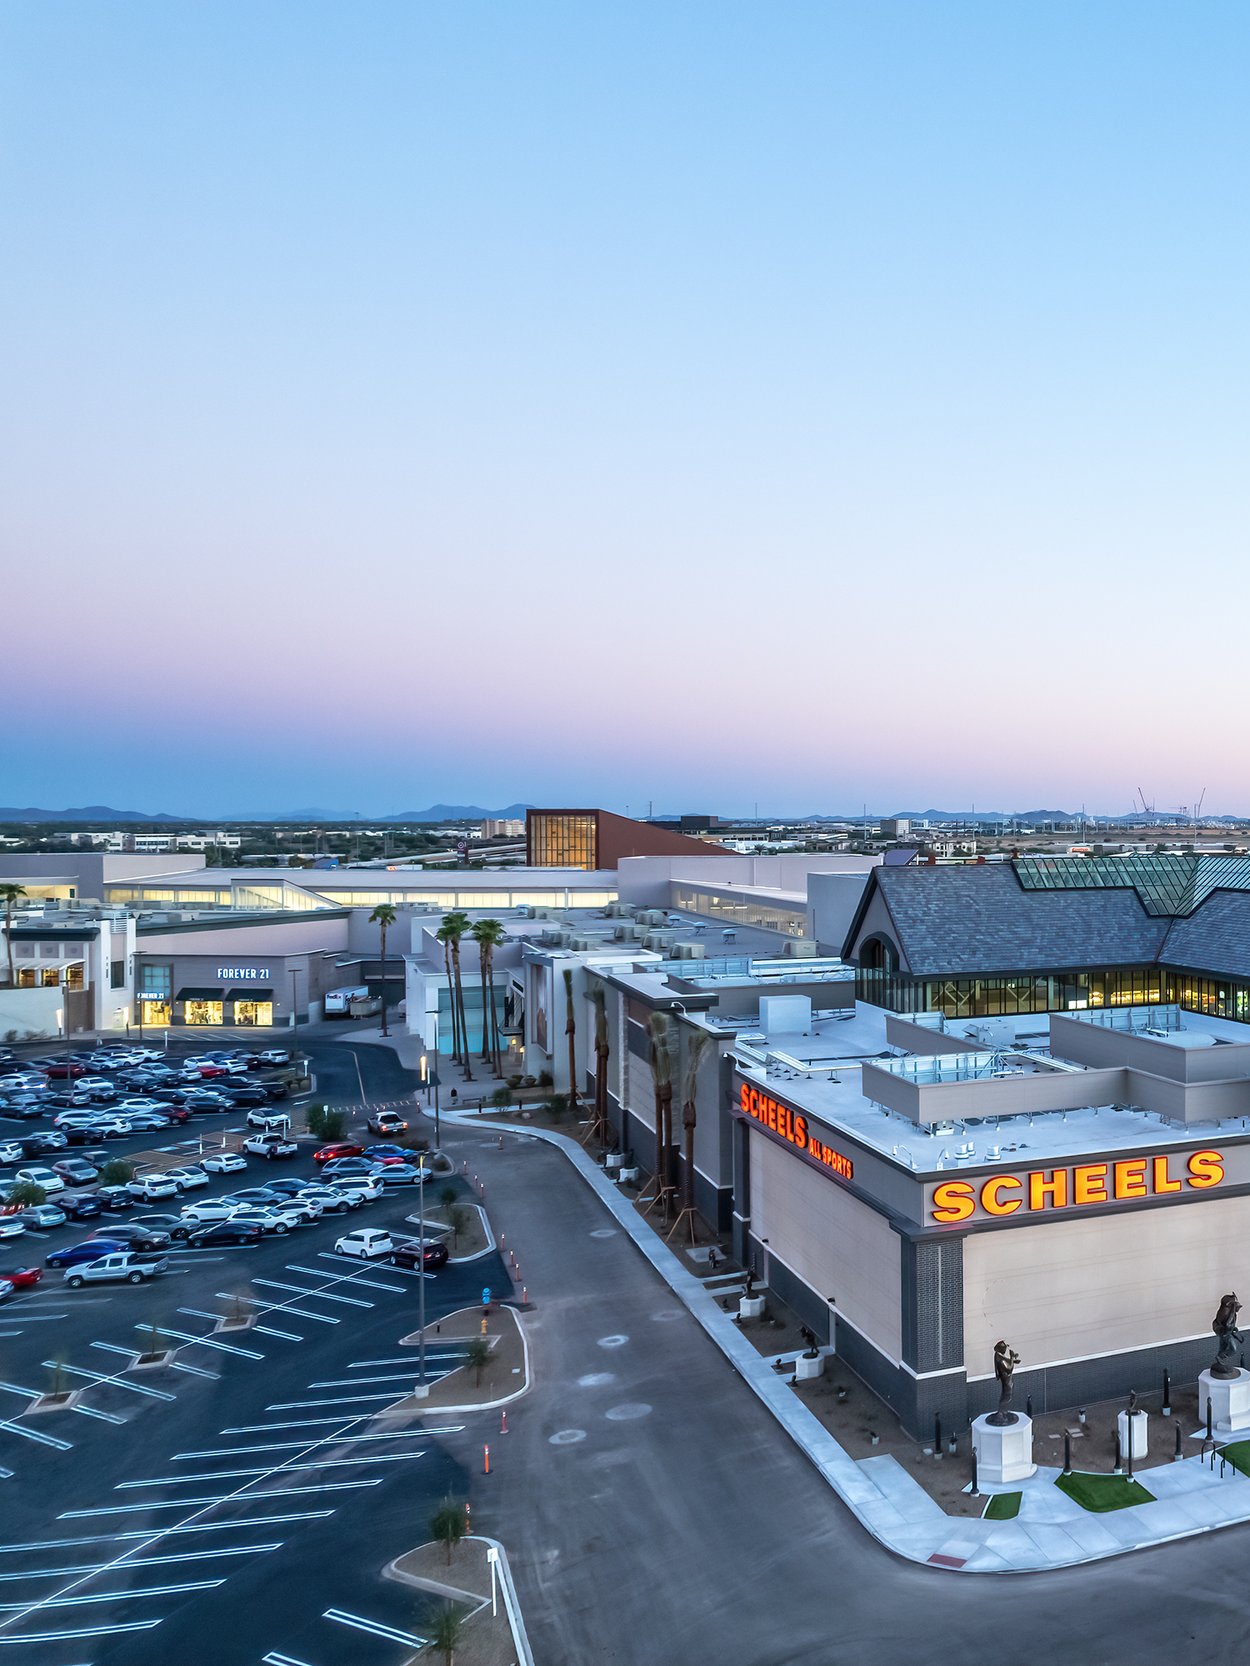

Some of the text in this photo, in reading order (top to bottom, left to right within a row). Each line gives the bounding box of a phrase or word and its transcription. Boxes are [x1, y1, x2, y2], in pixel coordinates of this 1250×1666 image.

[217, 968, 269, 979] FOREVER 21
[740, 1082, 854, 1180] SCHEELS ALL SPORTS
[931, 1150, 1225, 1223] SCHEELS
